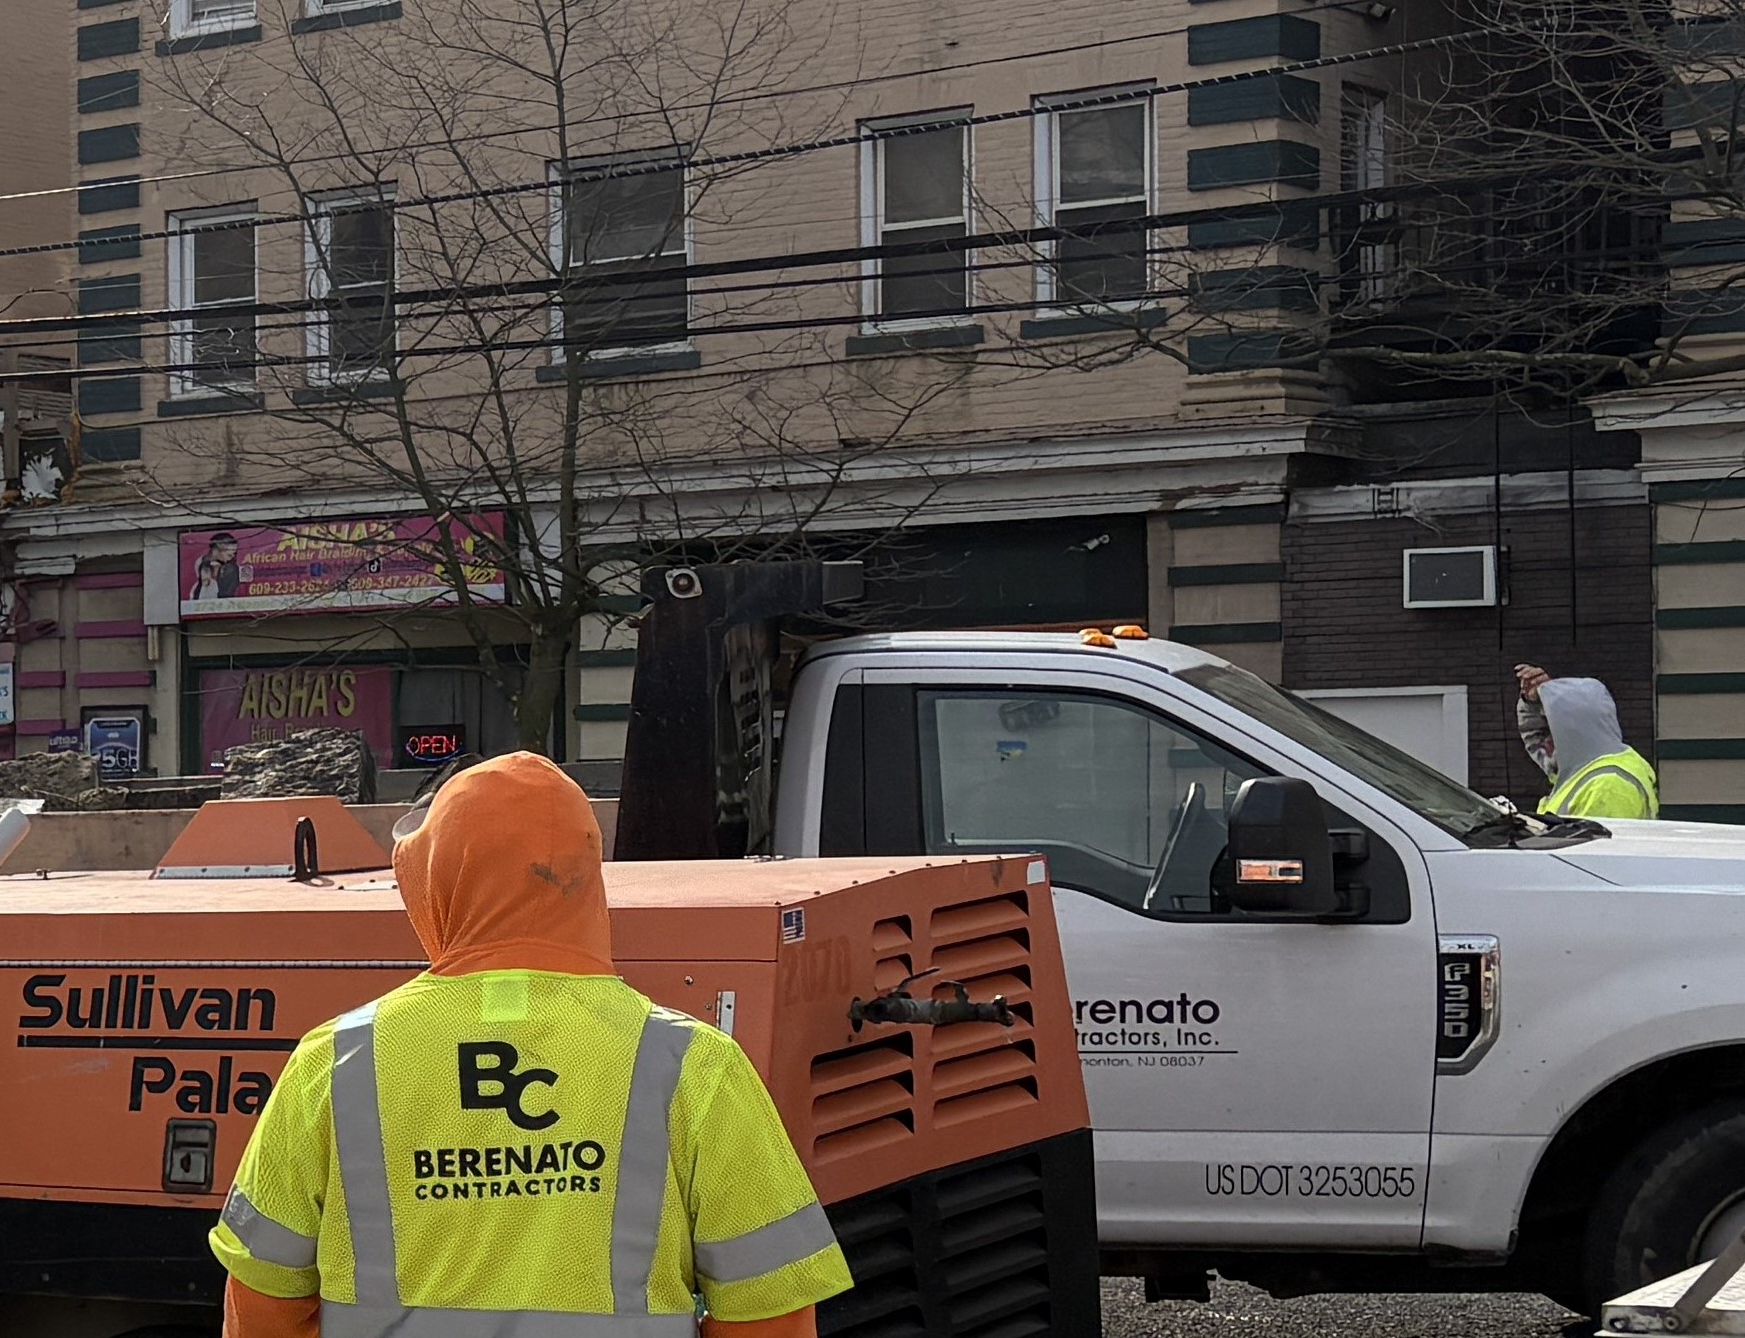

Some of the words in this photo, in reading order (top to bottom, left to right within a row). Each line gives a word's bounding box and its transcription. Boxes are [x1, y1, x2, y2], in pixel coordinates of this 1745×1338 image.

[243, 551, 287, 564] African
[237, 669, 356, 720] AISHA'S
[408, 734, 456, 756] OPEN
[17, 974, 277, 1031] Sullivan
[1075, 993, 1221, 1025] renato
[1443, 962, 1470, 1038] F350
[1074, 1027, 1168, 1047] tractors,
[1176, 1028, 1220, 1046] Inc.
[1137, 1056, 1156, 1067] NJ
[1159, 1056, 1206, 1068] 08037
[128, 1055, 274, 1115] Pala
[457, 1040, 561, 1131] BC
[414, 1139, 607, 1180] BERENATO
[414, 1175, 603, 1201] CONTRACTORS
[1205, 1164, 1235, 1195] US
[1240, 1165, 1294, 1196] DOT
[1298, 1165, 1416, 1198] 3253055
